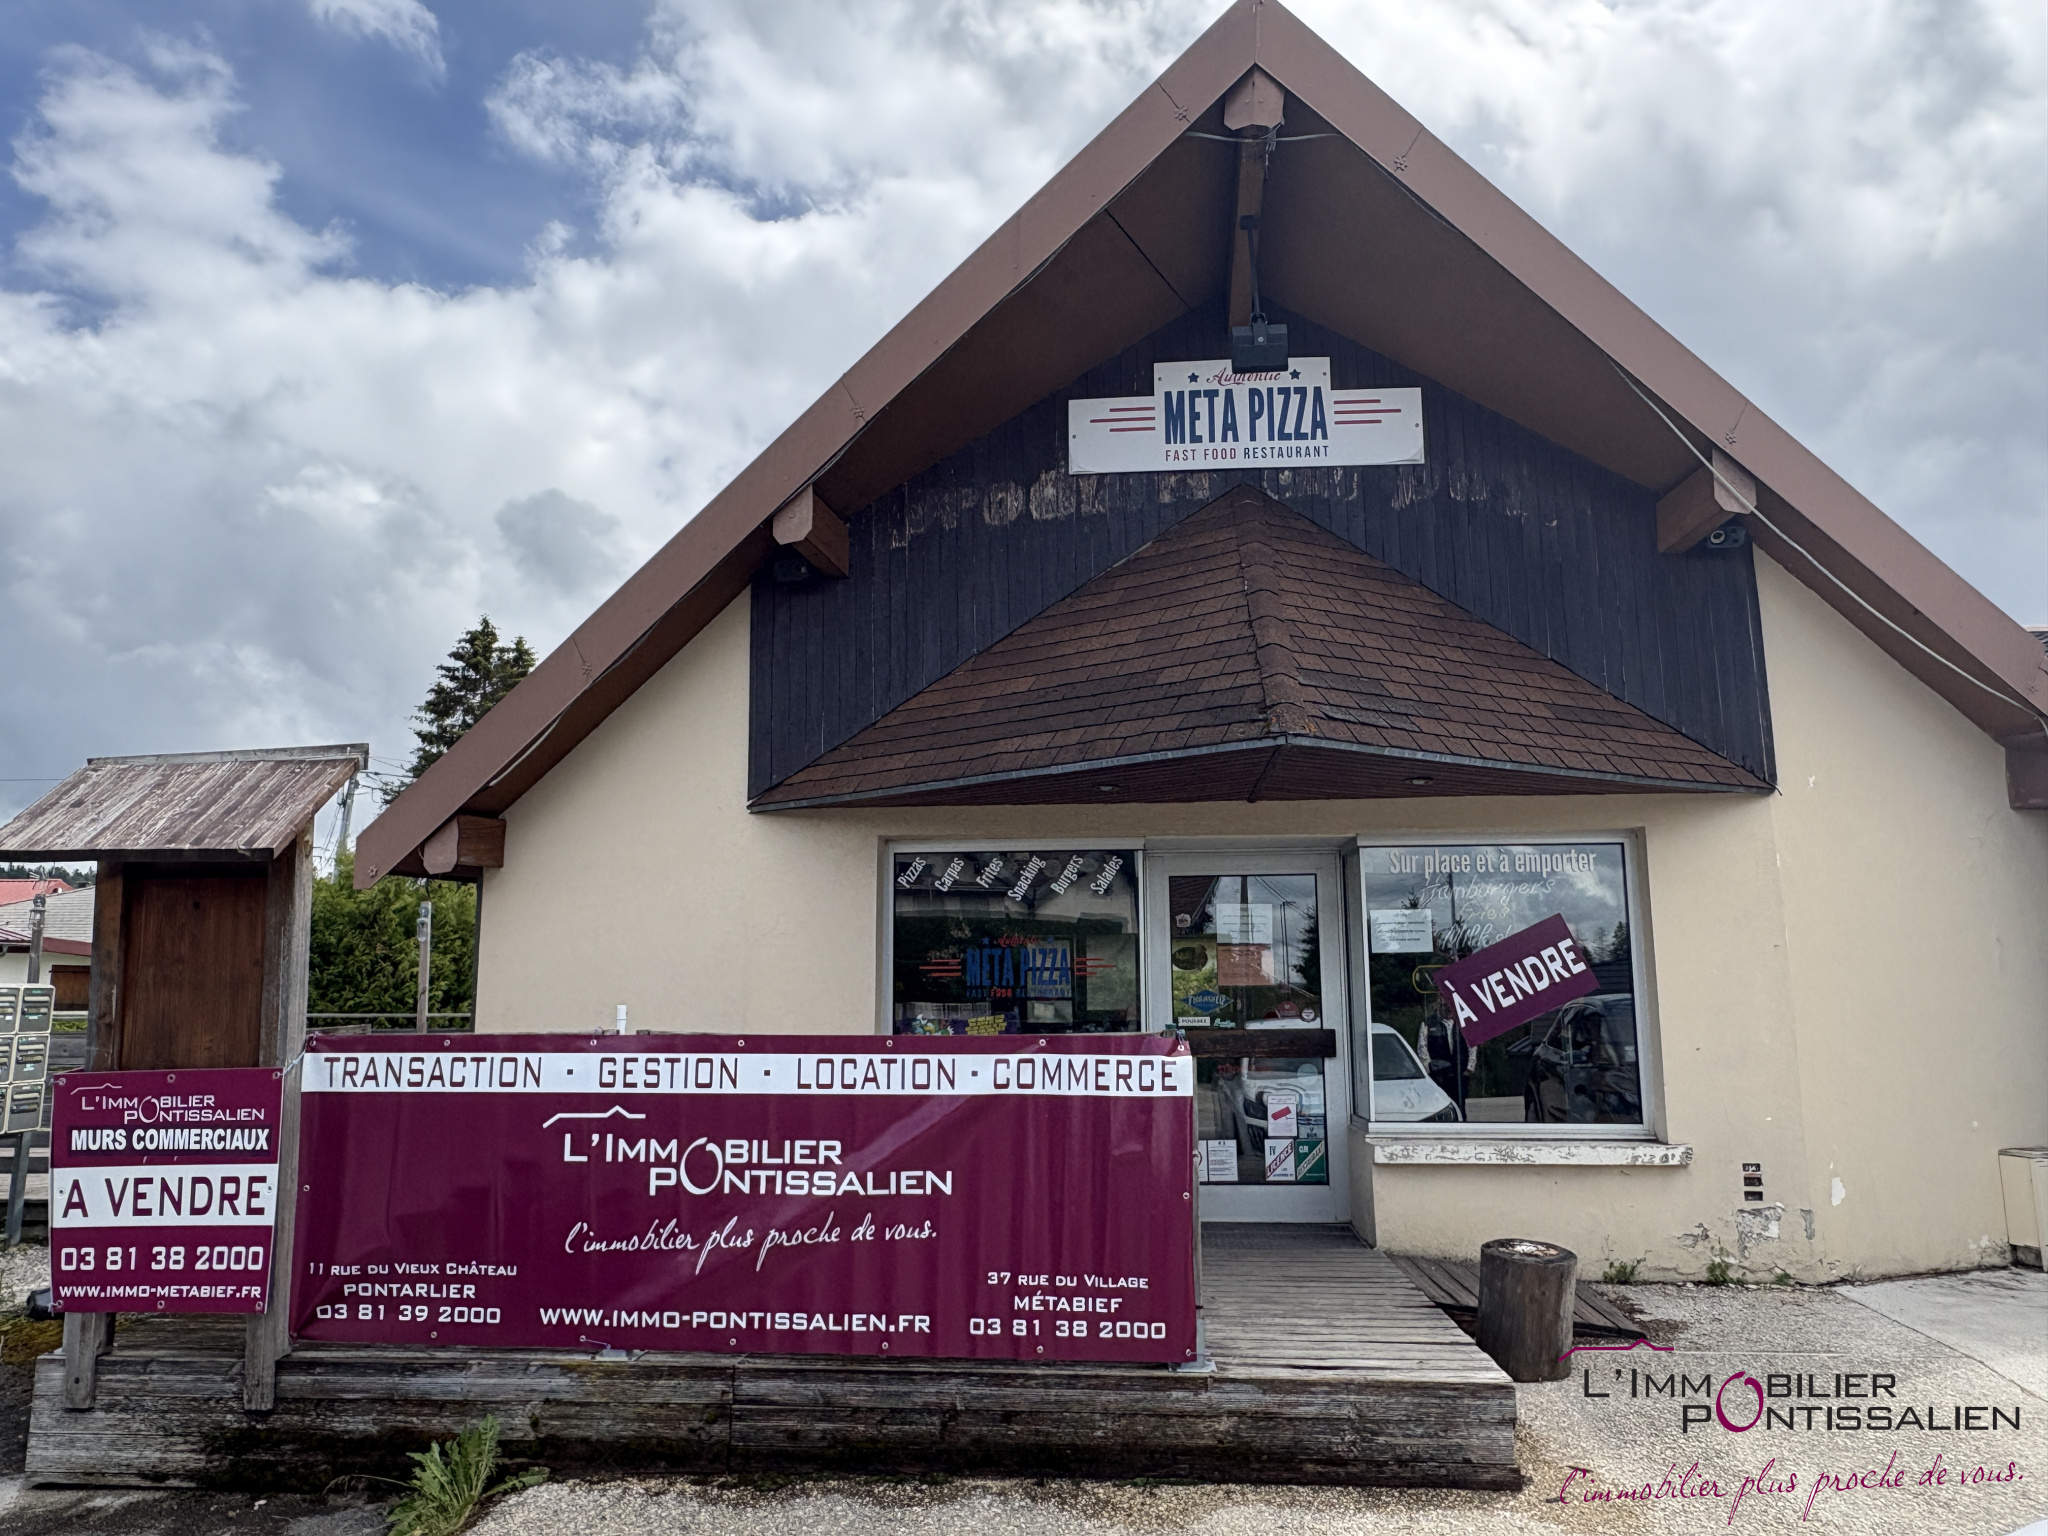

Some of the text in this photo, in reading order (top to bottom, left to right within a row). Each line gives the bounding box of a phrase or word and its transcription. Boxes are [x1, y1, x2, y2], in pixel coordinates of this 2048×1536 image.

[1164, 386, 1329, 444] META PIZZA
[1165, 445, 1329, 461] FAST FOOD RESTAURANT
[897, 856, 927, 889] Pizzas
[934, 857, 965, 892] Carpas
[976, 857, 1004, 888] Frites
[1007, 855, 1047, 901] Snacking
[1050, 854, 1084, 895] Burgers
[1090, 855, 1123, 895] Salades
[1389, 849, 1597, 879] Sur place et à emporter
[966, 948, 1071, 986] META PIZZA
[1444, 938, 1587, 1028] À VENDRE
[324, 1056, 1179, 1092] TRANSACTION GESTION LOCATION COMMERCE
[71, 1128, 270, 1151] MURS COMMERCIAUX
[62, 1175, 268, 1218] A VENDRE
[564, 1211, 938, 1275] l'immobilier plus proche de vous.
[60, 1246, 264, 1271] 03 81 38 2000
[309, 1260, 518, 1276] 11 RUE DU VIEUX CHÂTEAU
[59, 1285, 261, 1298] WWW.IMMO-METABIEF.FR
[343, 1283, 476, 1299] PONTARLIER
[987, 1271, 1149, 1289] 37 RUE DU VILLAGE
[316, 1304, 501, 1324] 03 81 39 2000
[1013, 1290, 1123, 1313] MÉTABIEF
[539, 1307, 931, 1333] WWW.IMMO-PONTISSALIEN.FR
[969, 1318, 1166, 1339] 03 81 38 2000
